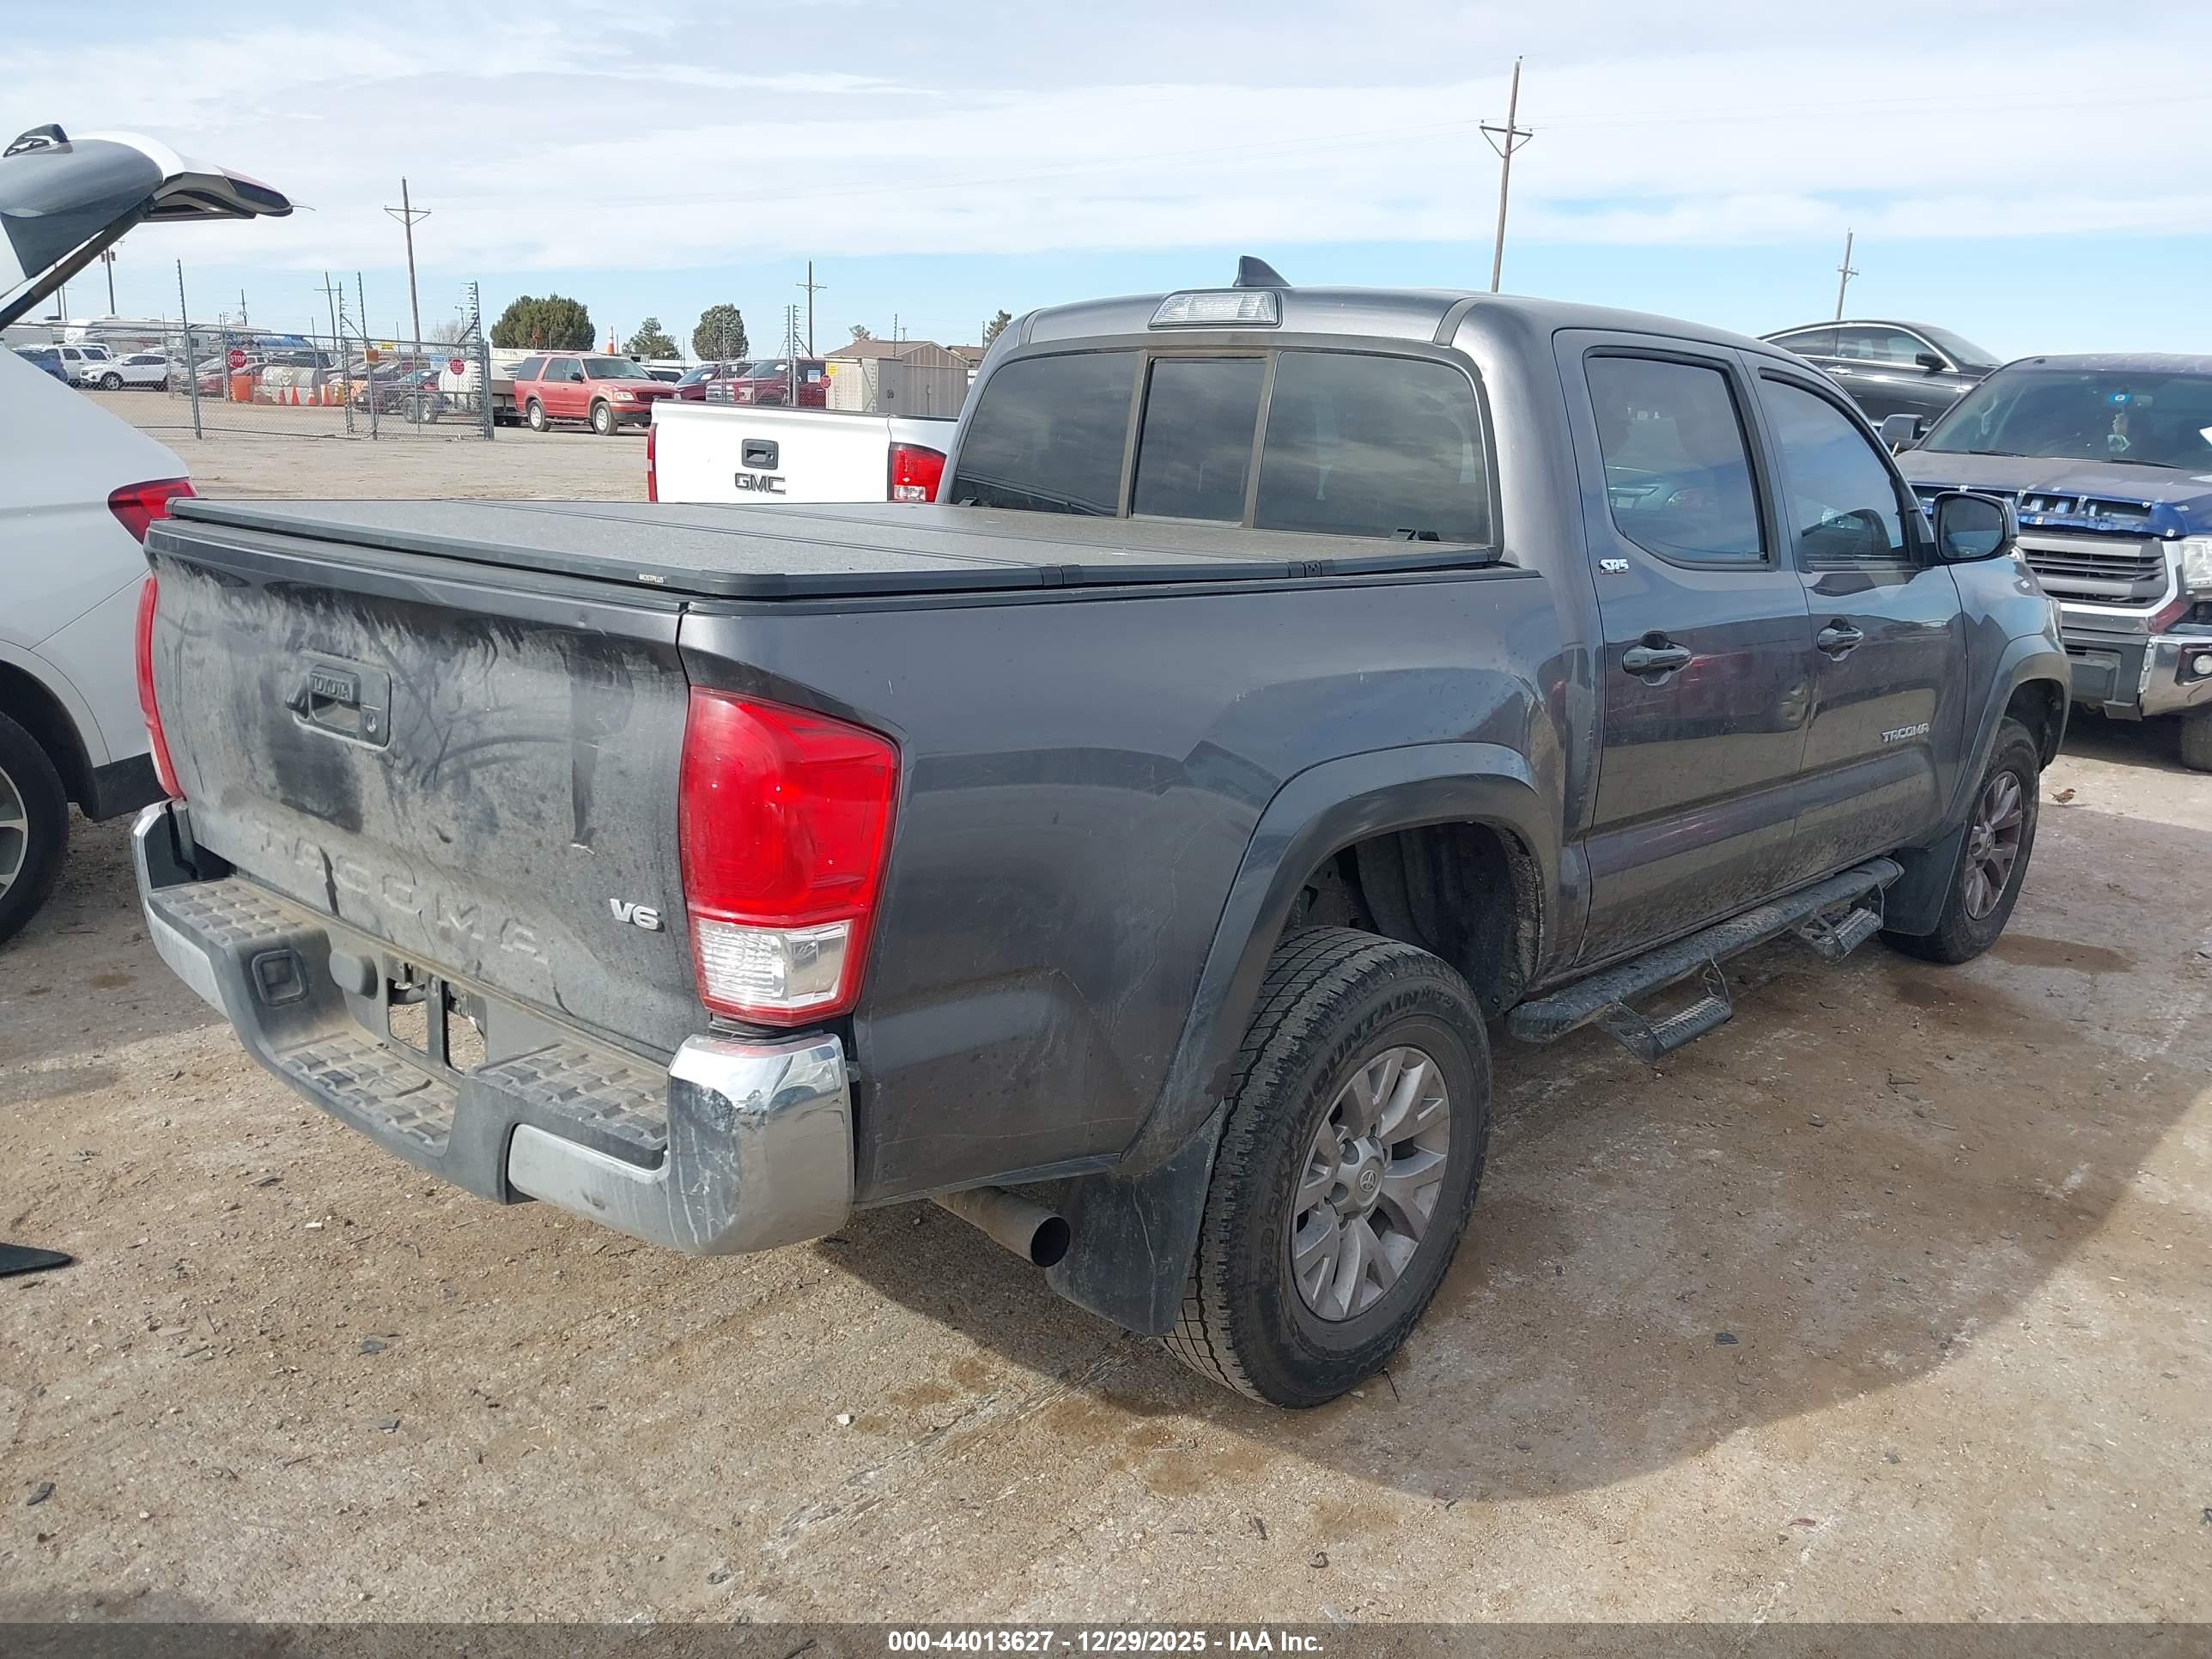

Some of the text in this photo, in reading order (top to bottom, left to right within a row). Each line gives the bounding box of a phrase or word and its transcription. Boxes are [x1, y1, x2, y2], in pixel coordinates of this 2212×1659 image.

[735, 472, 786, 495] GMC
[1600, 558, 1629, 570] SR5
[311, 673, 353, 701] TOYOTA
[1881, 722, 1929, 743] TACOMA
[256, 823, 550, 965] TACOMA
[609, 897, 659, 931] V6
